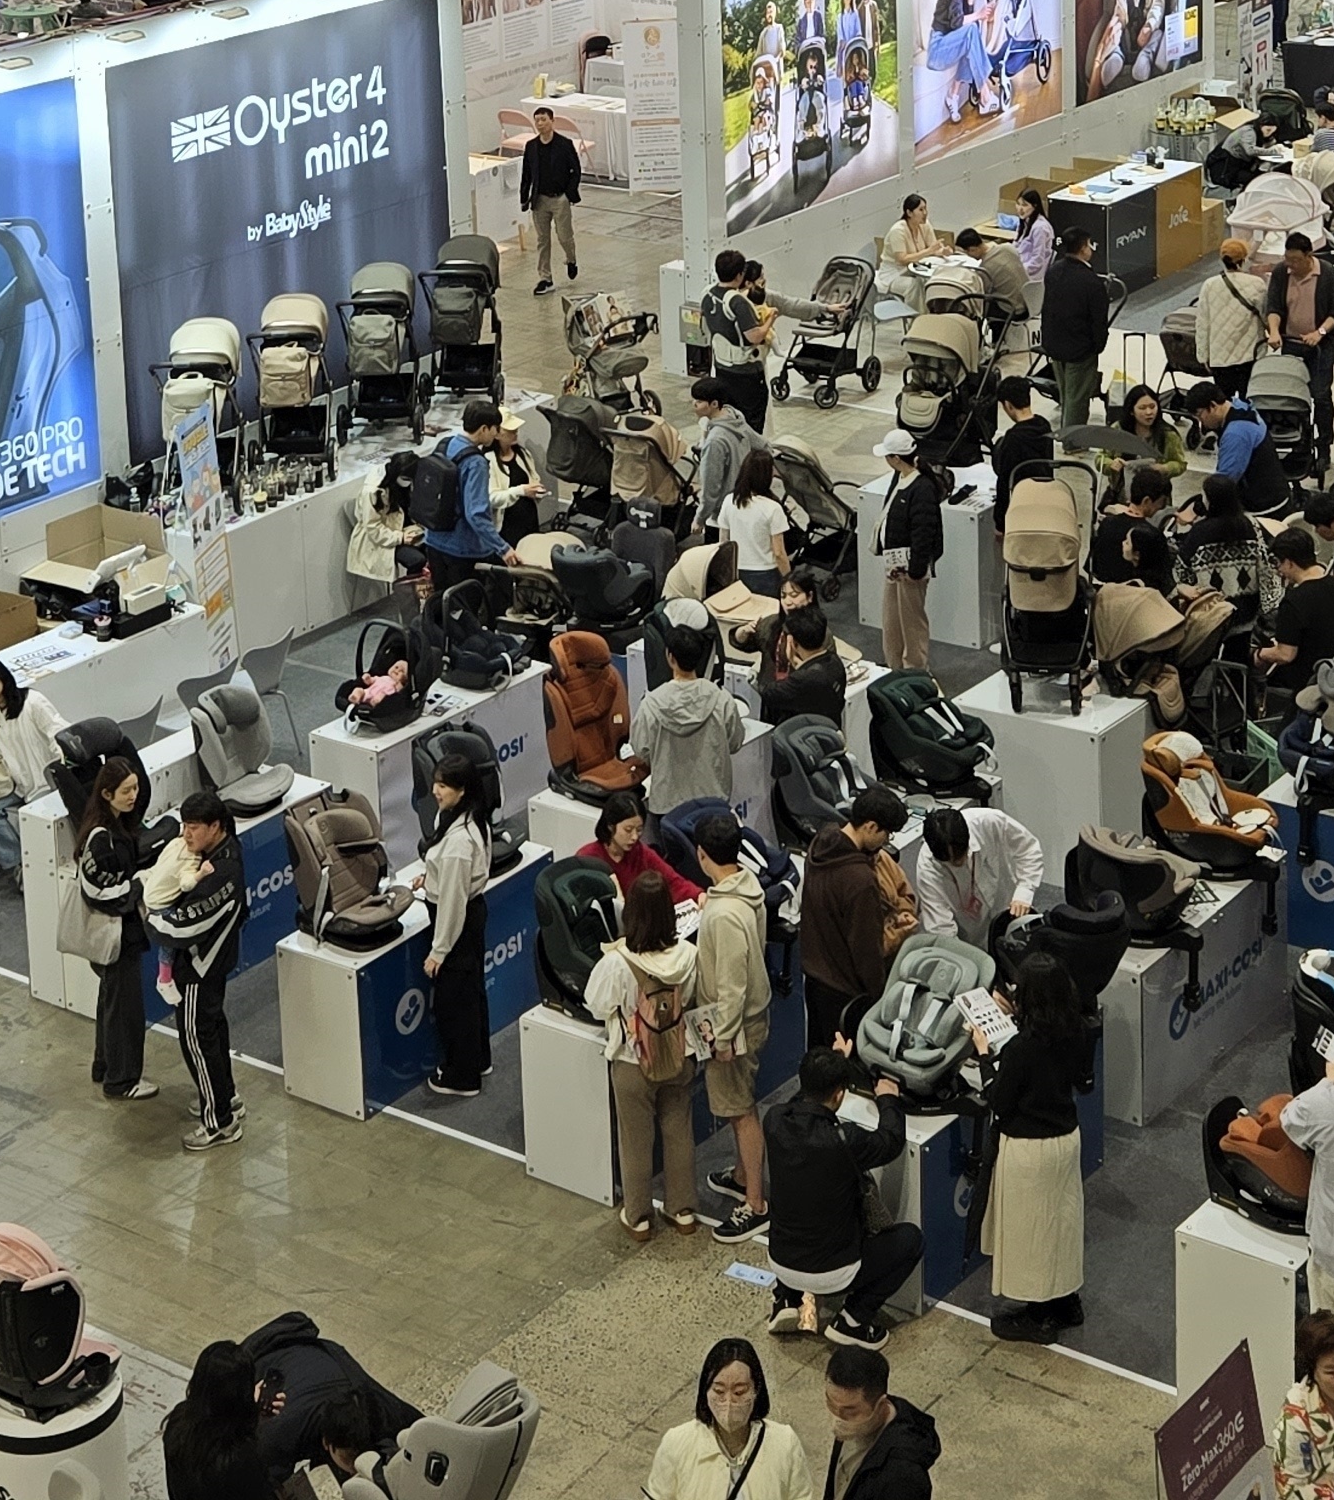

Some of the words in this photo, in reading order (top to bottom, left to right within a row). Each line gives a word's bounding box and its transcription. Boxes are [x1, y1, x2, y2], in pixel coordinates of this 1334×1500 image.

[246, 224, 264, 242] by
[265, 194, 332, 238] BabyStyle
[1168, 204, 1189, 229] Joie
[1115, 226, 1148, 249] RYAN
[41, 416, 84, 452] PRO
[20, 441, 87, 489] TECH
